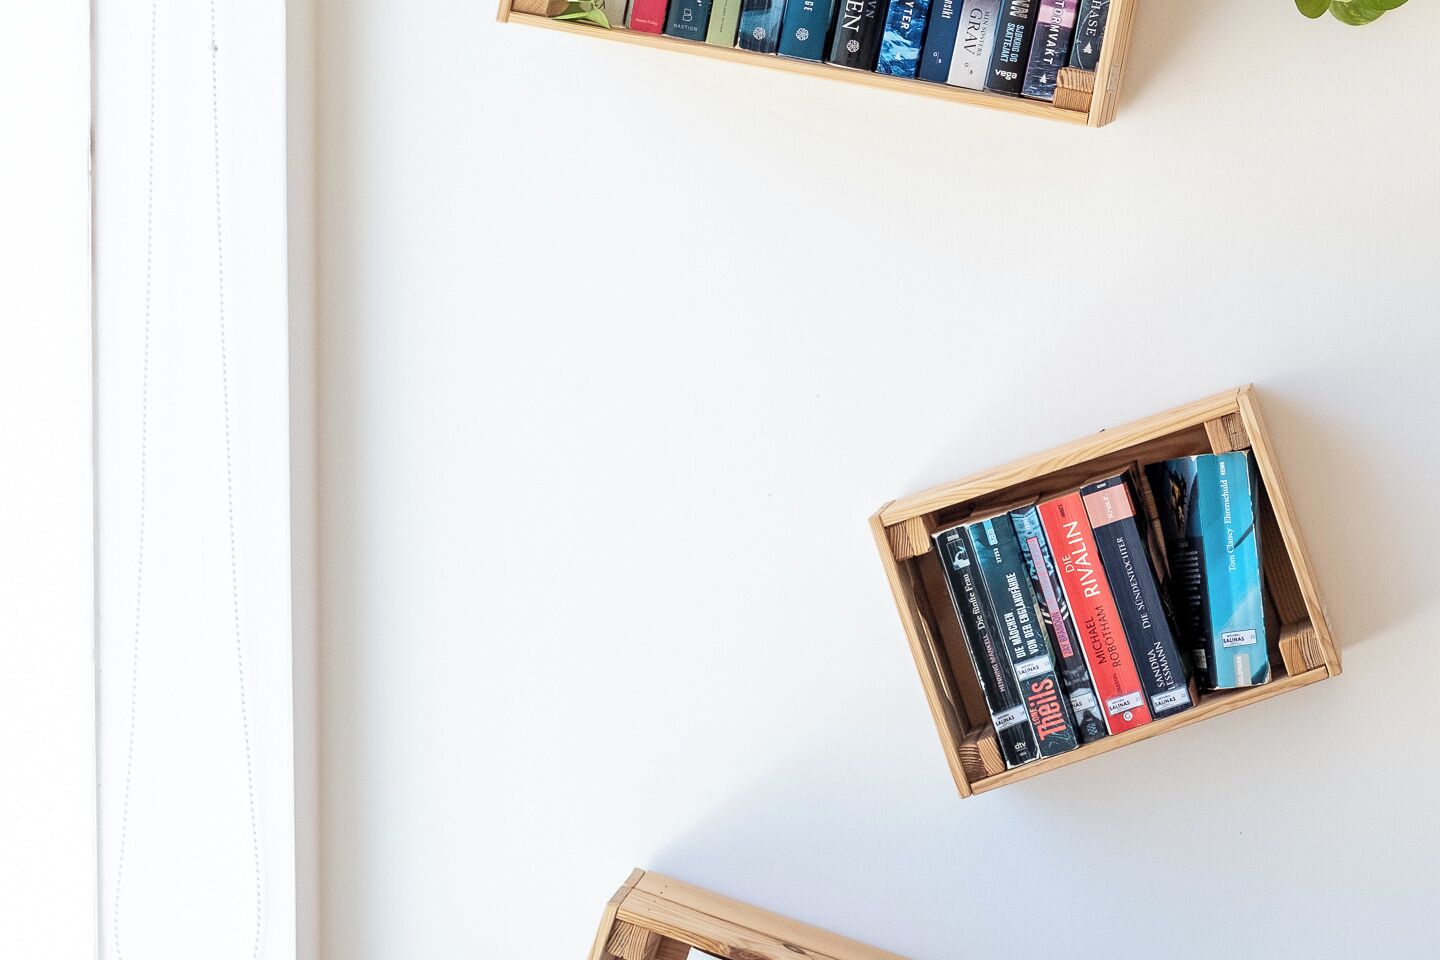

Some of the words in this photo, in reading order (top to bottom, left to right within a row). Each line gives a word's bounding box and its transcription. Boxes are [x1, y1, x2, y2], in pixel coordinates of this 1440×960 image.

[961, 7, 983, 55] GRAV
[1218, 479, 1231, 524] Ehrenschuld
[1224, 526, 1235, 553] Clancy
[1061, 553, 1075, 573] DIE
[1062, 520, 1101, 597] RIVALIN
[1227, 553, 1237, 572] Tom
[961, 573, 974, 592] Frau
[1115, 536, 1146, 610] SÜNDENTOCHTER
[966, 591, 981, 614] fünfte
[1005, 572, 1030, 622] ENGLANDFÄHRE
[973, 614, 986, 630] Die
[1003, 611, 1022, 645] MÄDCHEN
[1020, 622, 1034, 638] DER
[1050, 611, 1067, 642] BRANDON
[1138, 612, 1151, 628] DIE
[982, 633, 996, 663] MANKELL
[1025, 637, 1039, 654] VON
[1060, 642, 1071, 655] JAY
[1084, 615, 1106, 664] MICHAEL
[1094, 604, 1122, 667] ROBOTHAM
[1013, 644, 1026, 658] DIE
[991, 663, 1005, 691] HENNING
[1146, 648, 1164, 687] SANDRA
